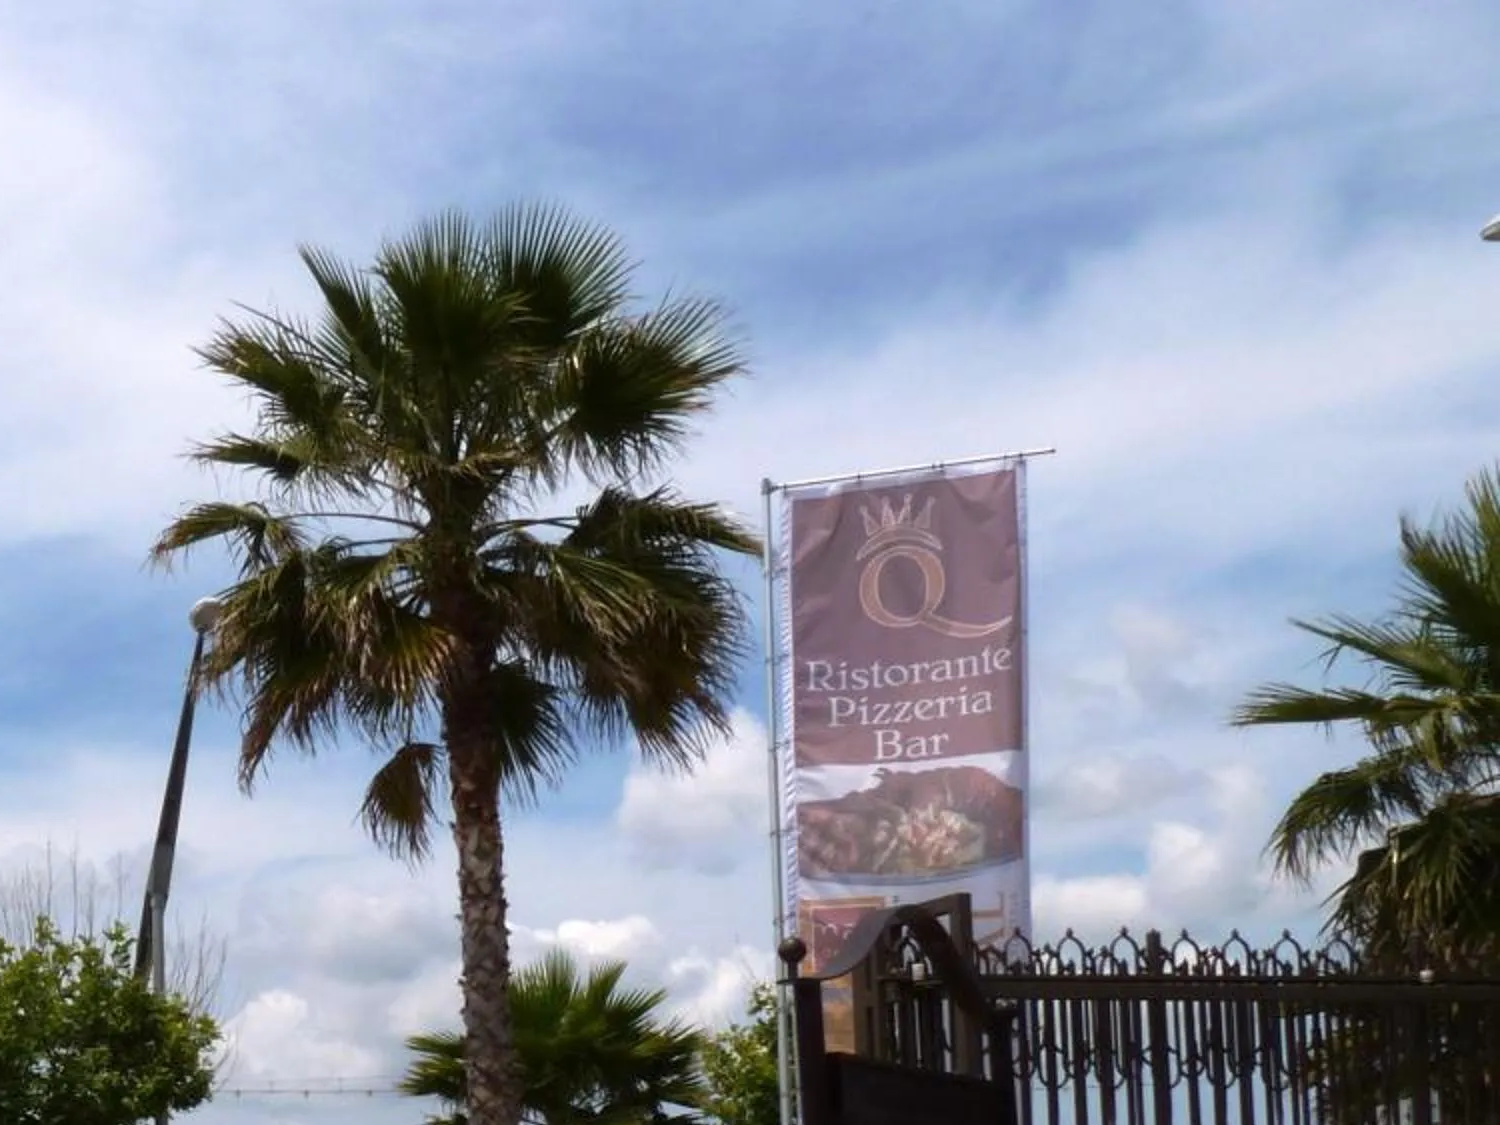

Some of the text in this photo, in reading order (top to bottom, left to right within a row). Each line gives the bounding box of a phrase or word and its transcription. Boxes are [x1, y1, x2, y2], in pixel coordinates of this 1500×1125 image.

[806, 645, 1013, 692] Ristorante
[827, 686, 993, 728] Pizzeria
[874, 728, 949, 761] Bar
